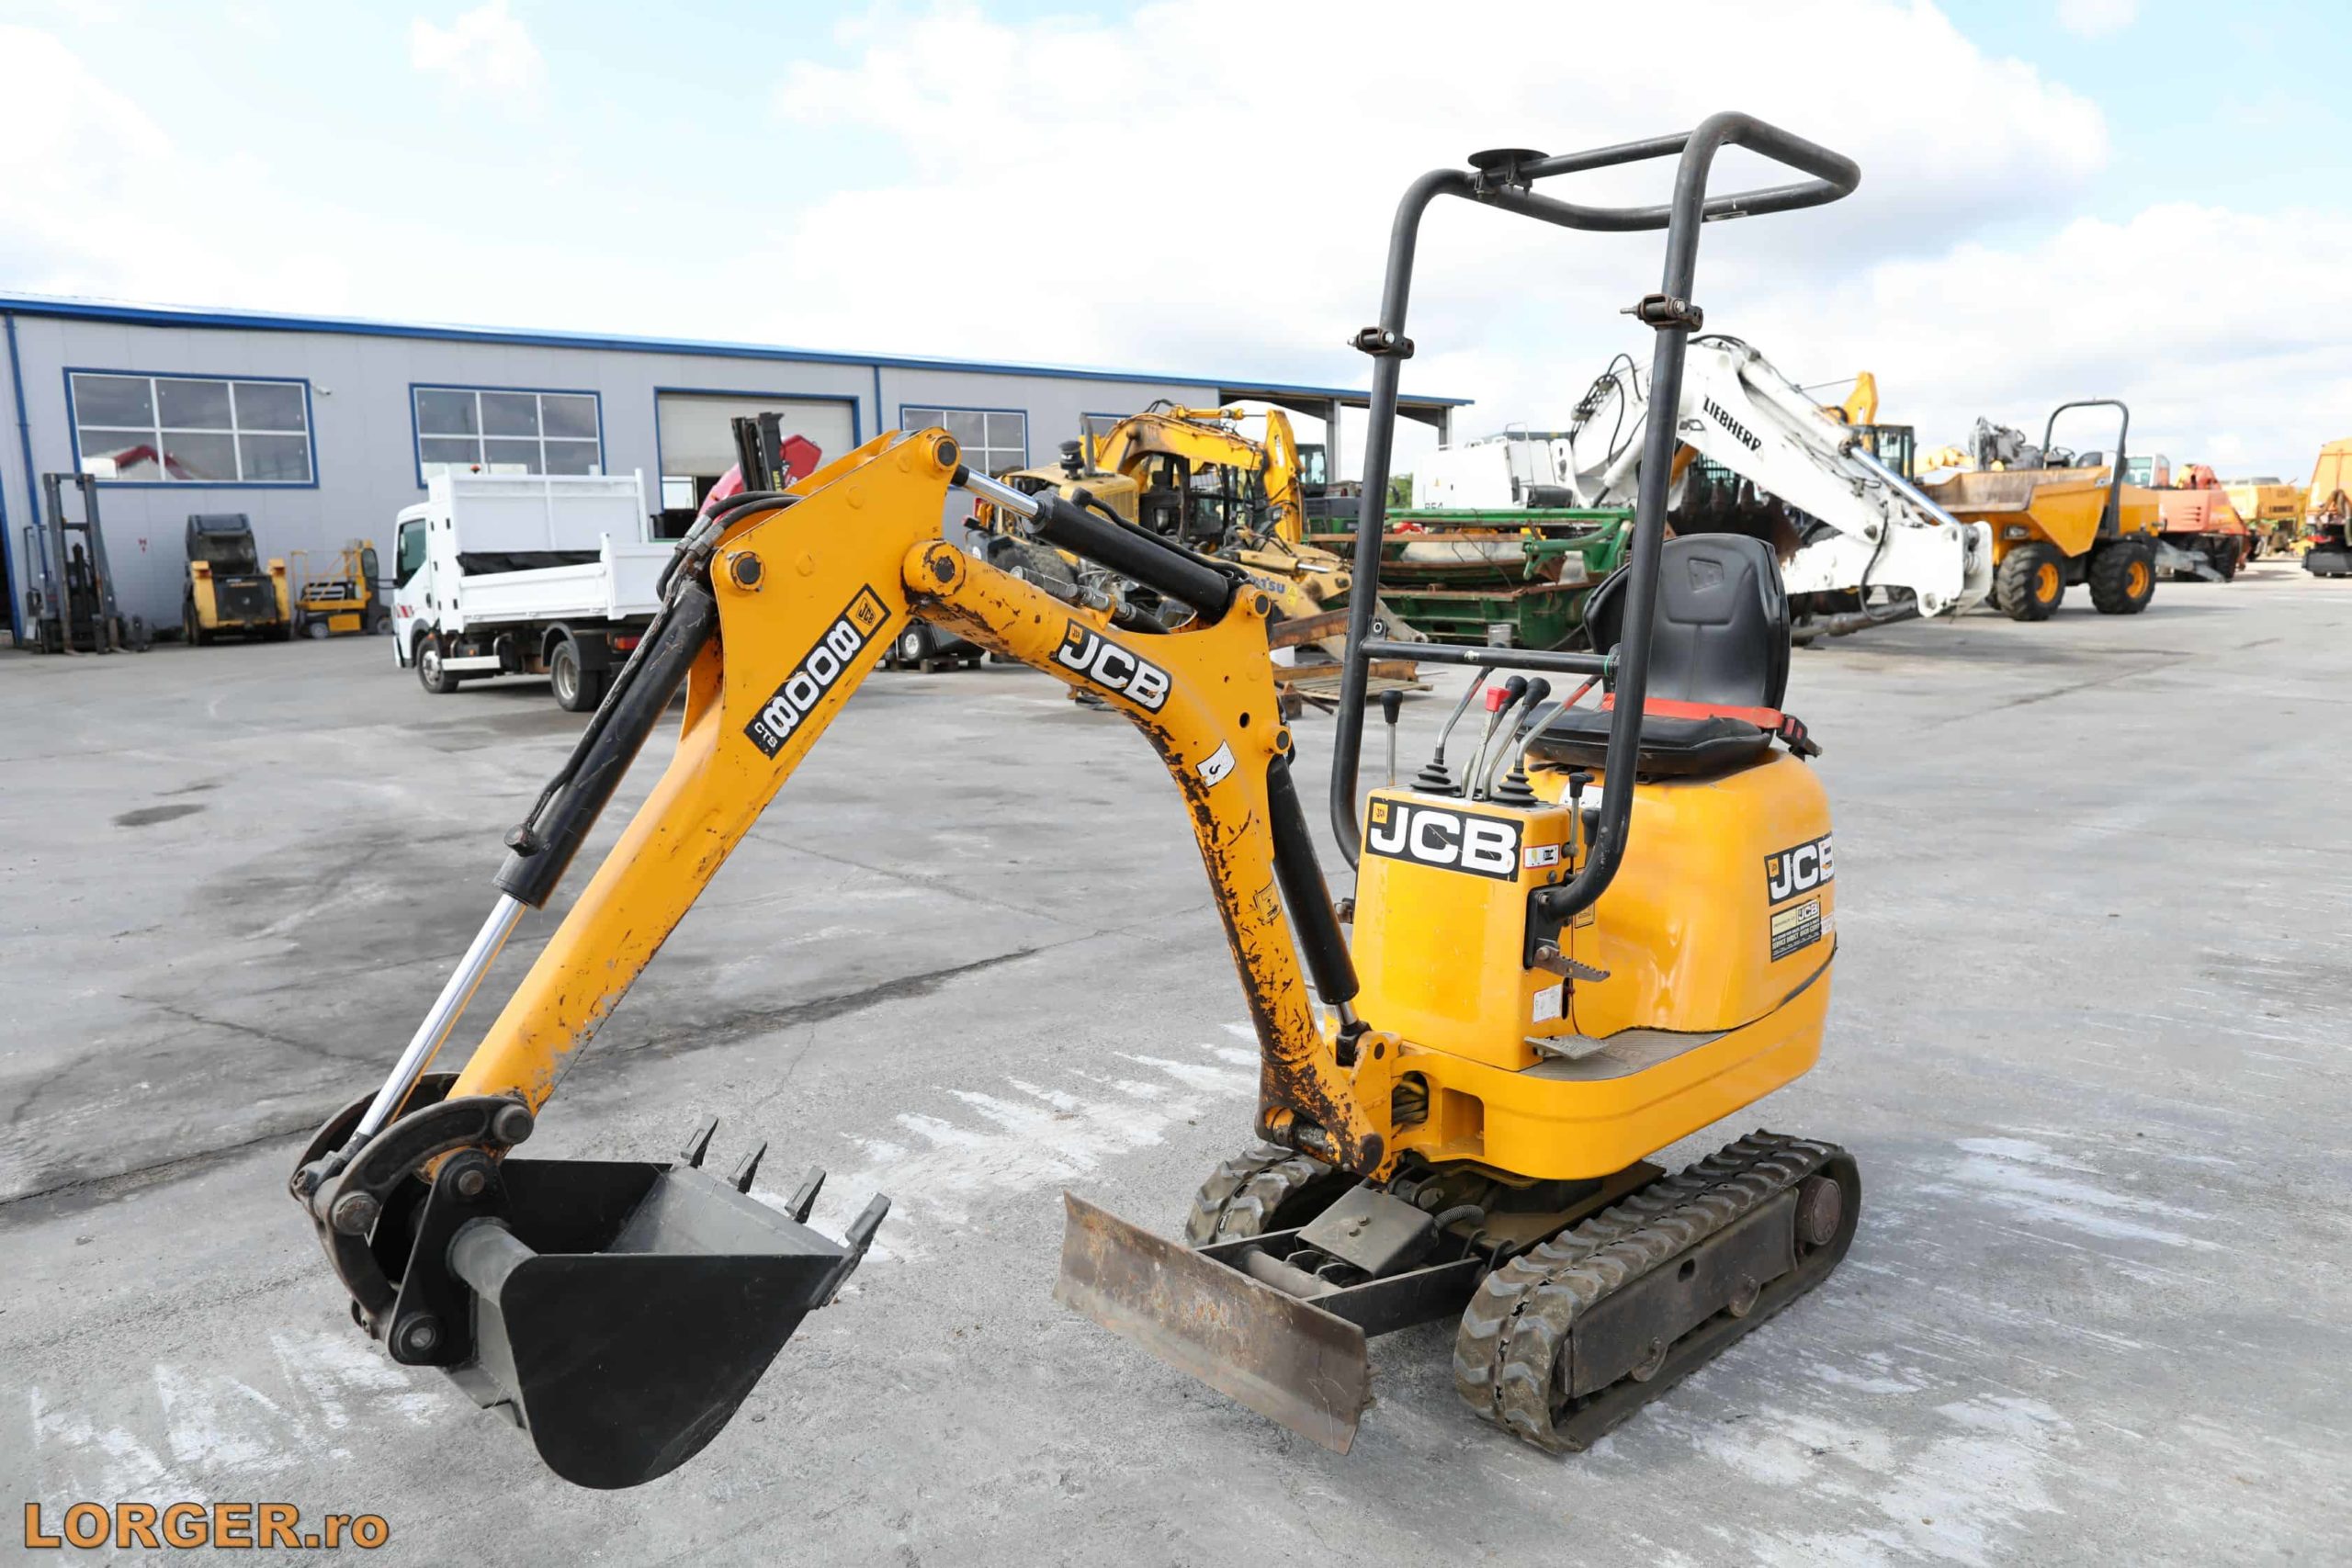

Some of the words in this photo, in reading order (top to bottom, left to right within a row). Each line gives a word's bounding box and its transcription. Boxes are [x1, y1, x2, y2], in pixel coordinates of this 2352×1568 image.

[855, 602, 876, 624] JCB
[763, 620, 862, 738] 8008
[1058, 634, 1169, 709] JCB
[753, 722, 778, 748] CTS
[1370, 806, 1517, 874] JCB
[1770, 836, 1835, 900] JCB
[1797, 901, 1819, 921] JCB
